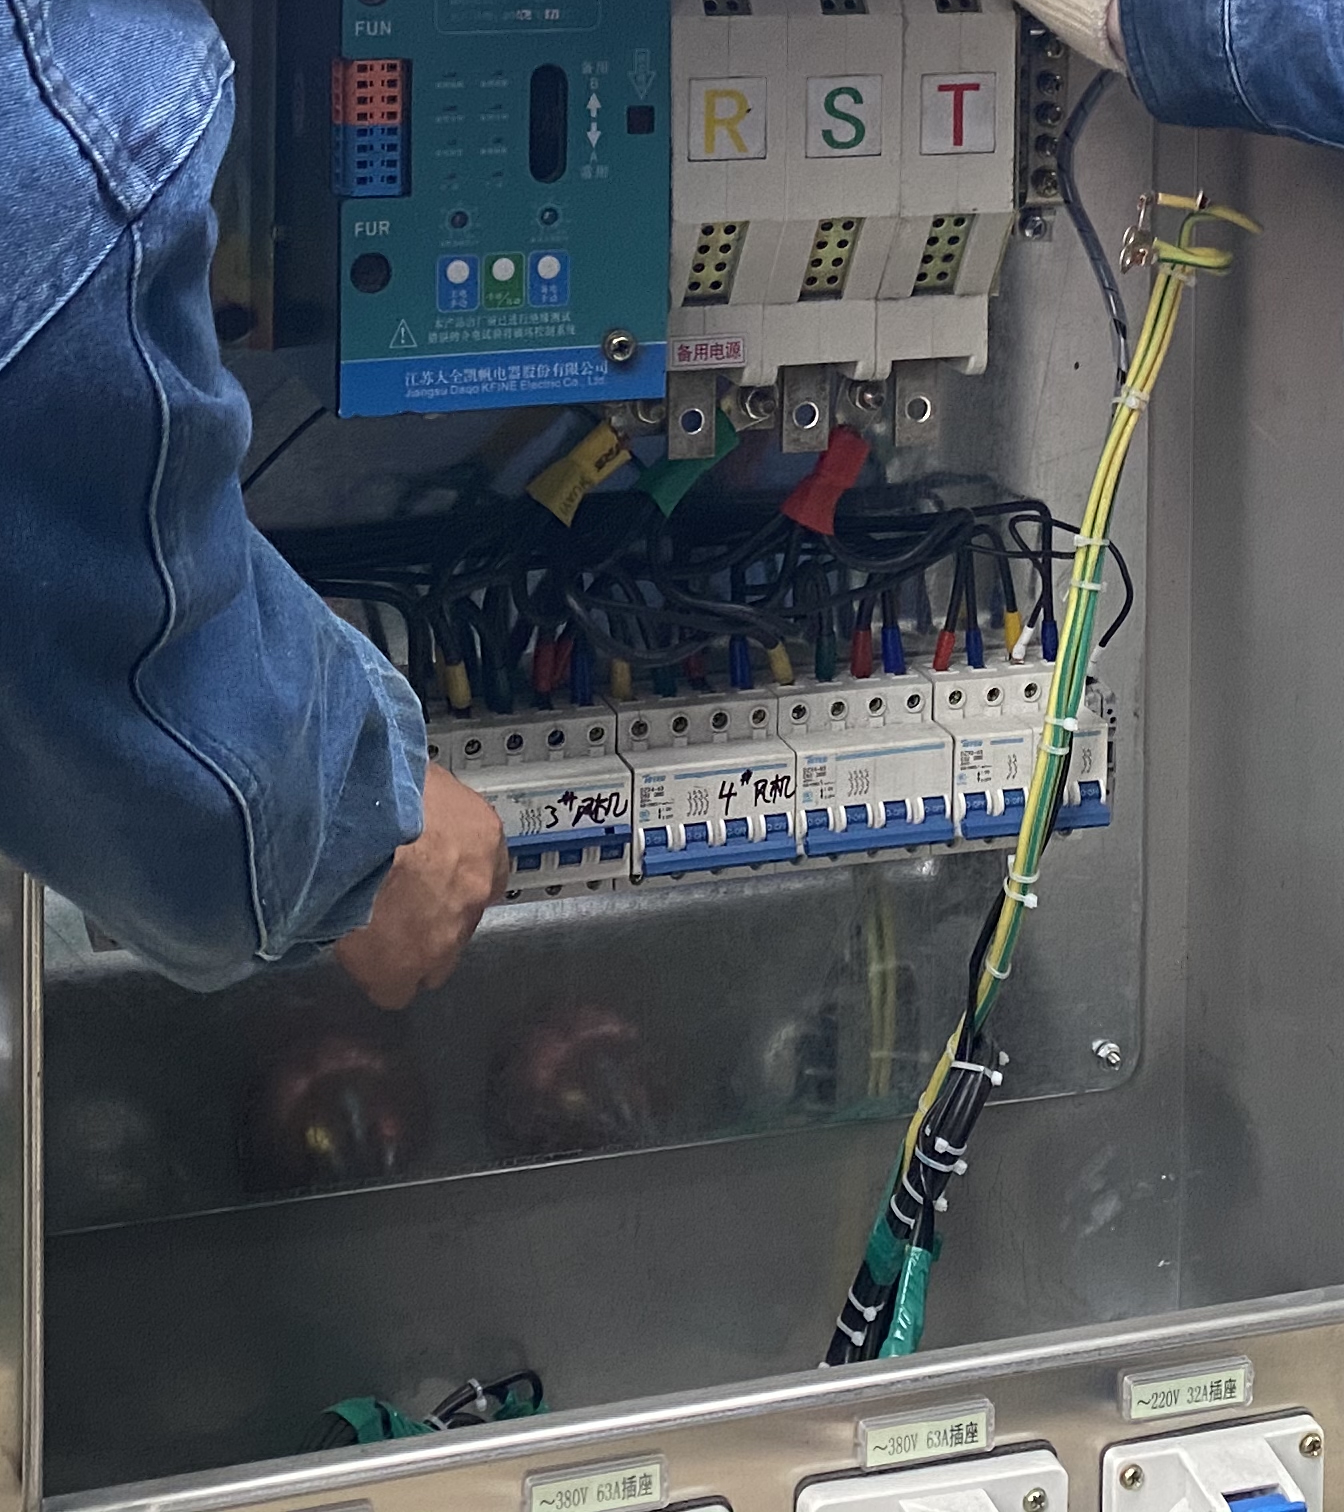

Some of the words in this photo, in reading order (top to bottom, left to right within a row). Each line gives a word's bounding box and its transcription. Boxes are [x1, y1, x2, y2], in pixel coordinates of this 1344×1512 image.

[354, 19, 392, 36] FUN
[703, 89, 750, 155] R
[821, 86, 866, 150] S
[937, 83, 981, 147] T
[354, 221, 391, 236] FUR
[676, 341, 742, 361] 备用电源
[405, 386, 448, 399] Jiangsu
[1186, 1377, 1237, 1405] 32A插座
[926, 1421, 979, 1450] 63A插座
[596, 1472, 654, 1503] 63A插座
